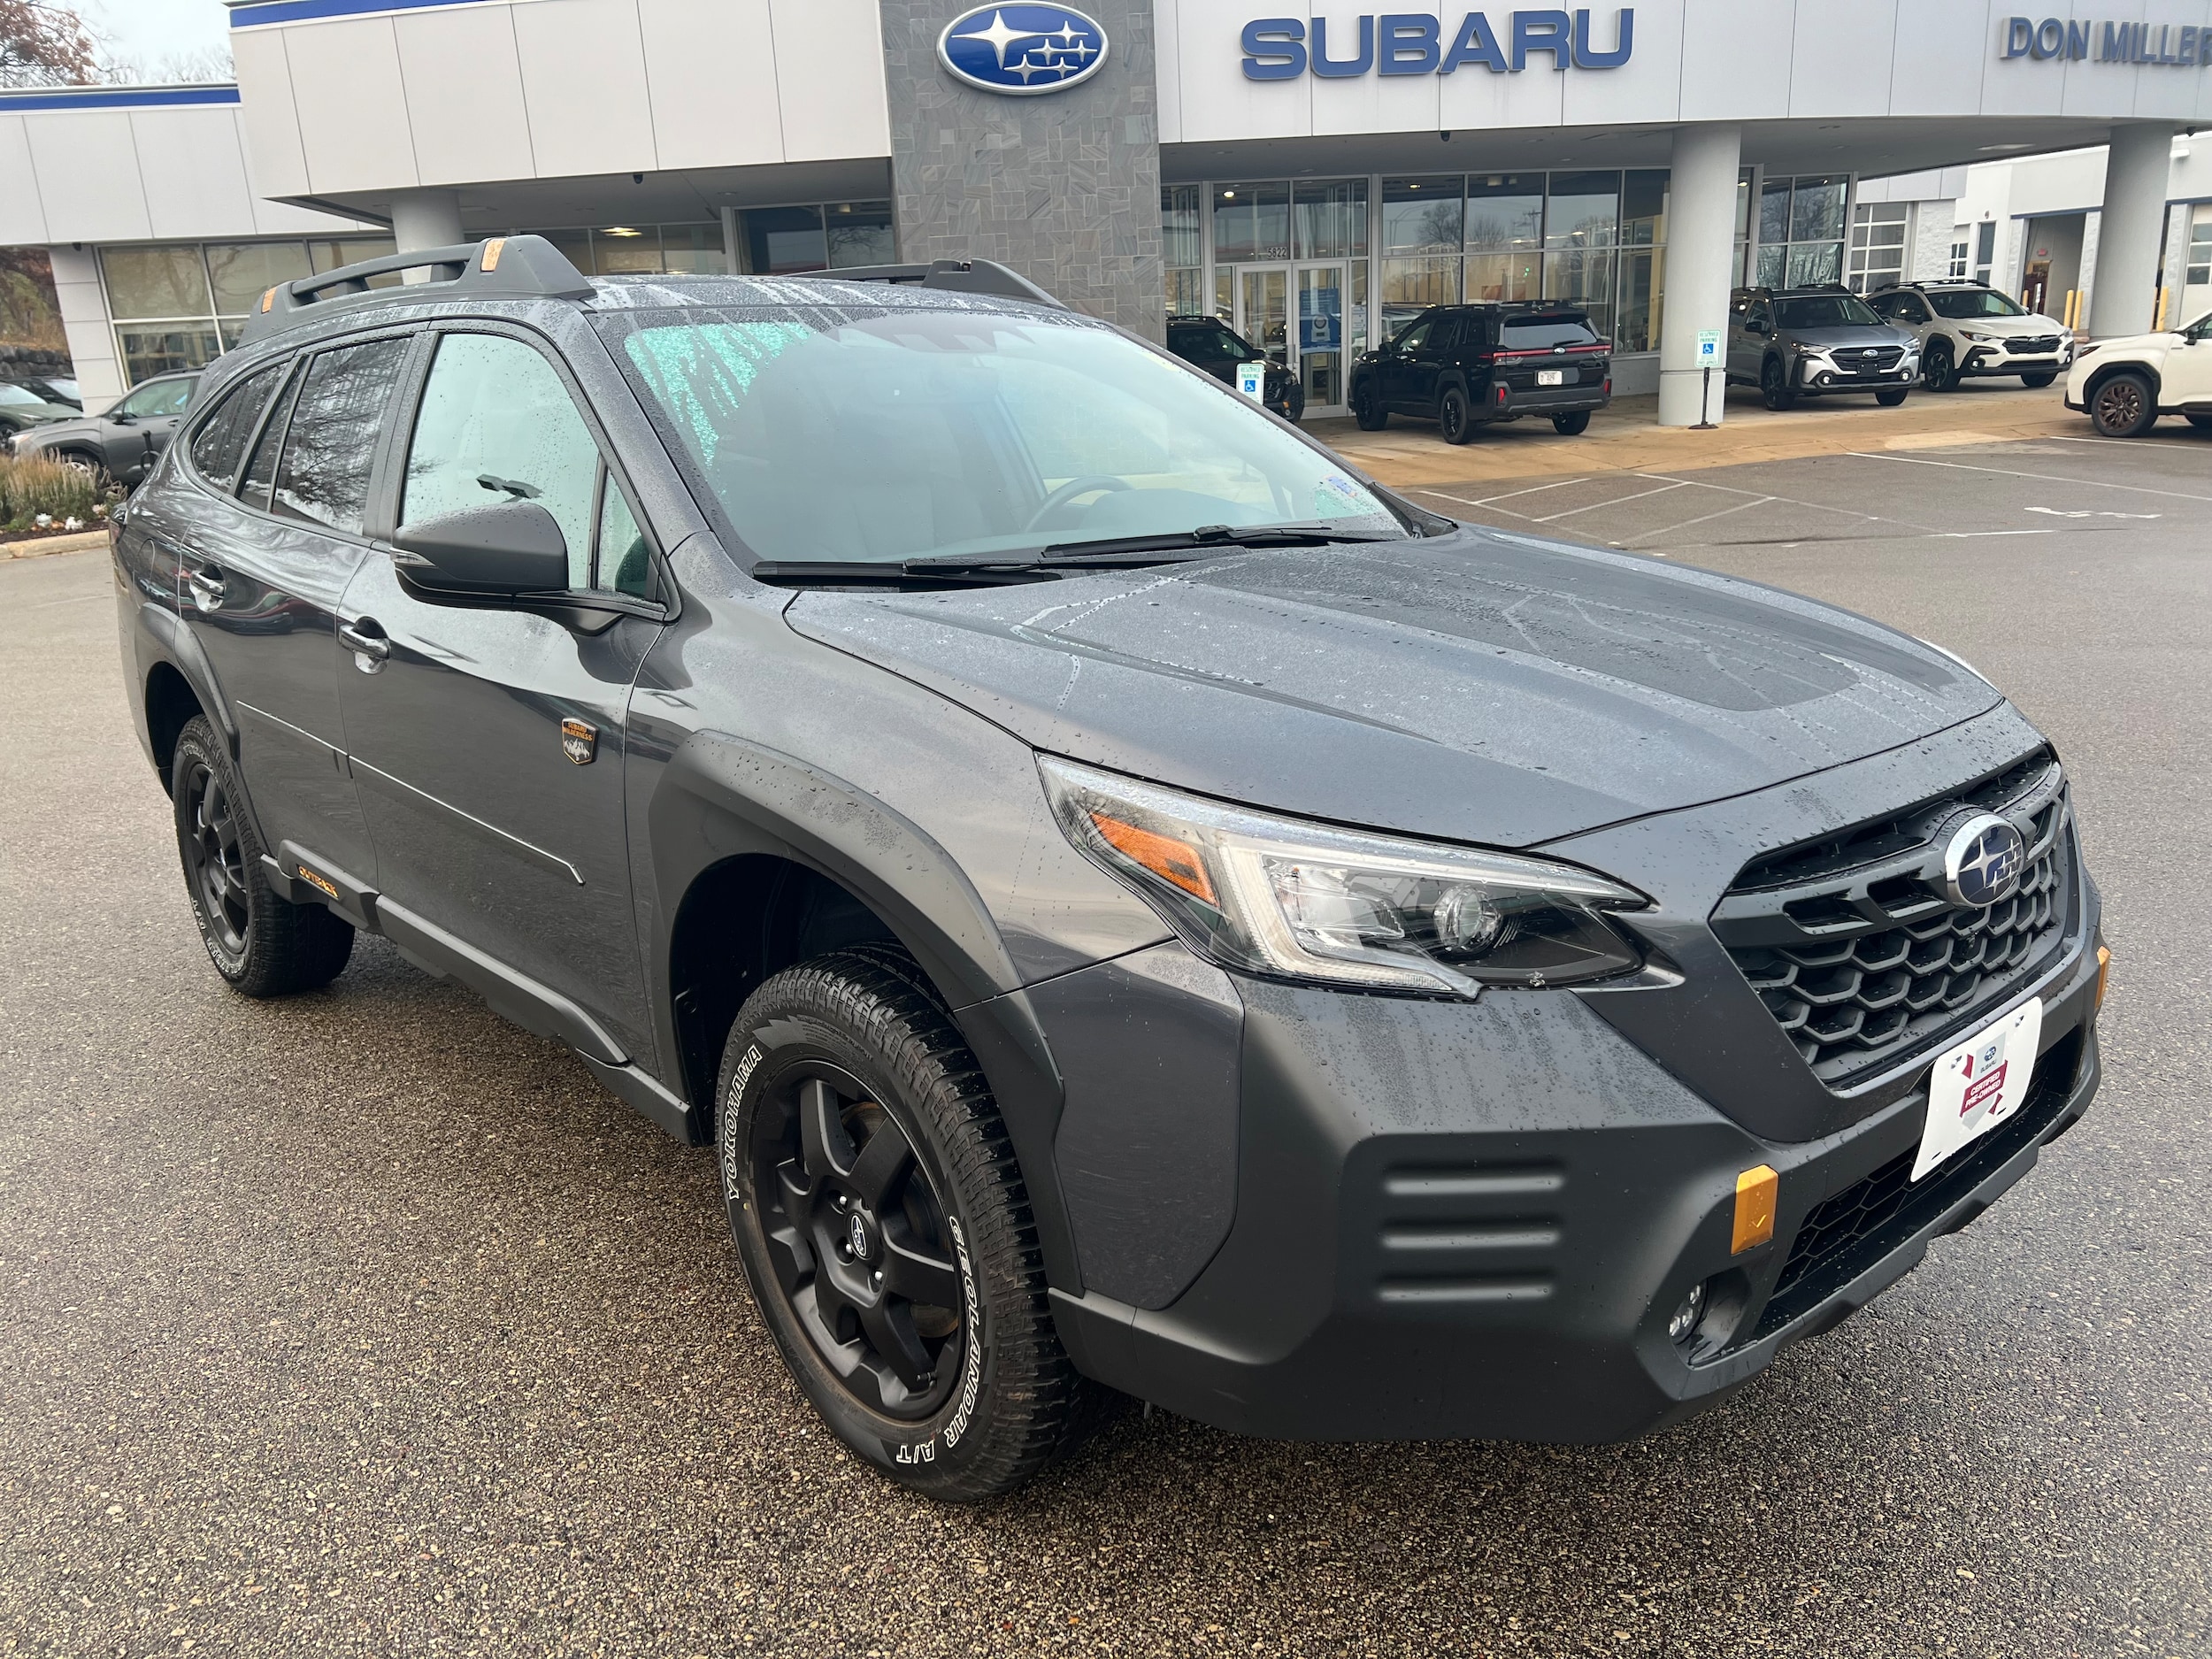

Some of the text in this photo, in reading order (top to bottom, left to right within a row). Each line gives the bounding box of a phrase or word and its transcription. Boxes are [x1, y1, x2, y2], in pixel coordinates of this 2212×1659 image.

[1240, 8, 1634, 81] SUBARU
[2000, 16, 2212, 65] DON MILLER
[1267, 247, 1287, 257] 5822
[563, 726, 593, 741] WILDERNESS
[298, 865, 338, 898] OUTBACK
[1964, 1079, 2001, 1109] PRE-OWNED
[1970, 1071, 2001, 1096] CERTIFIED
[724, 1043, 763, 1200] YOKOHAMA
[895, 1216, 980, 1464] GEOLANDAR A/T
